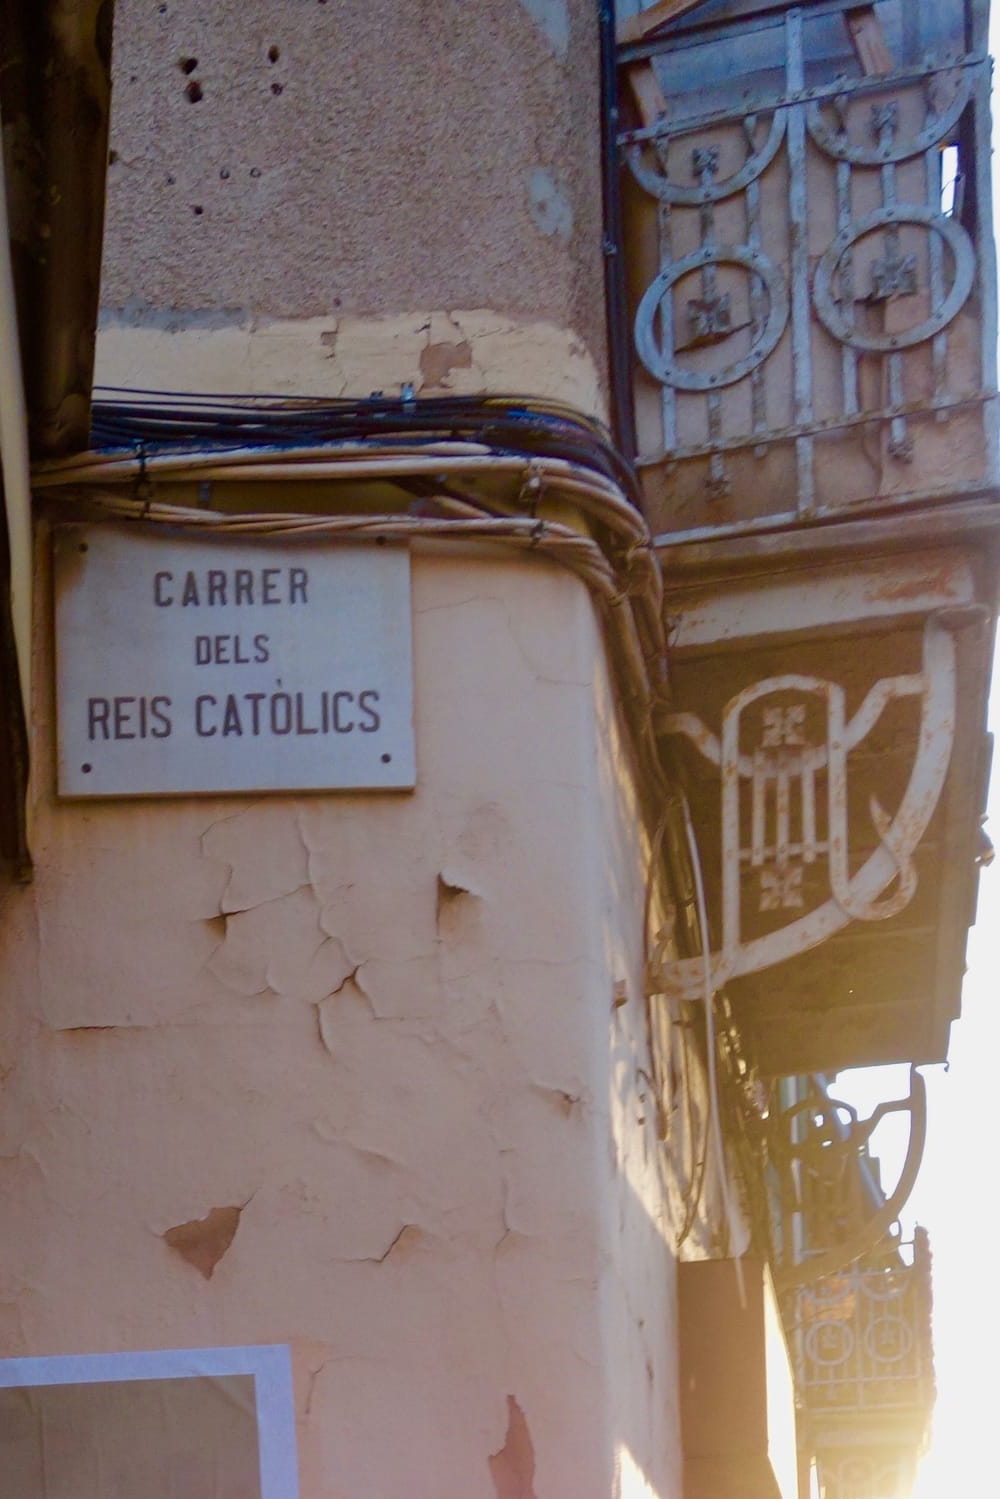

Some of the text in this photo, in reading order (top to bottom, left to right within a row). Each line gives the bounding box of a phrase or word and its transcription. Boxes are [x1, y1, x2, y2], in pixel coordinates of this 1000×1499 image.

[153, 567, 309, 608] CARRER
[195, 634, 270, 665] DELS
[87, 679, 381, 741] REIS CATÒLICS
